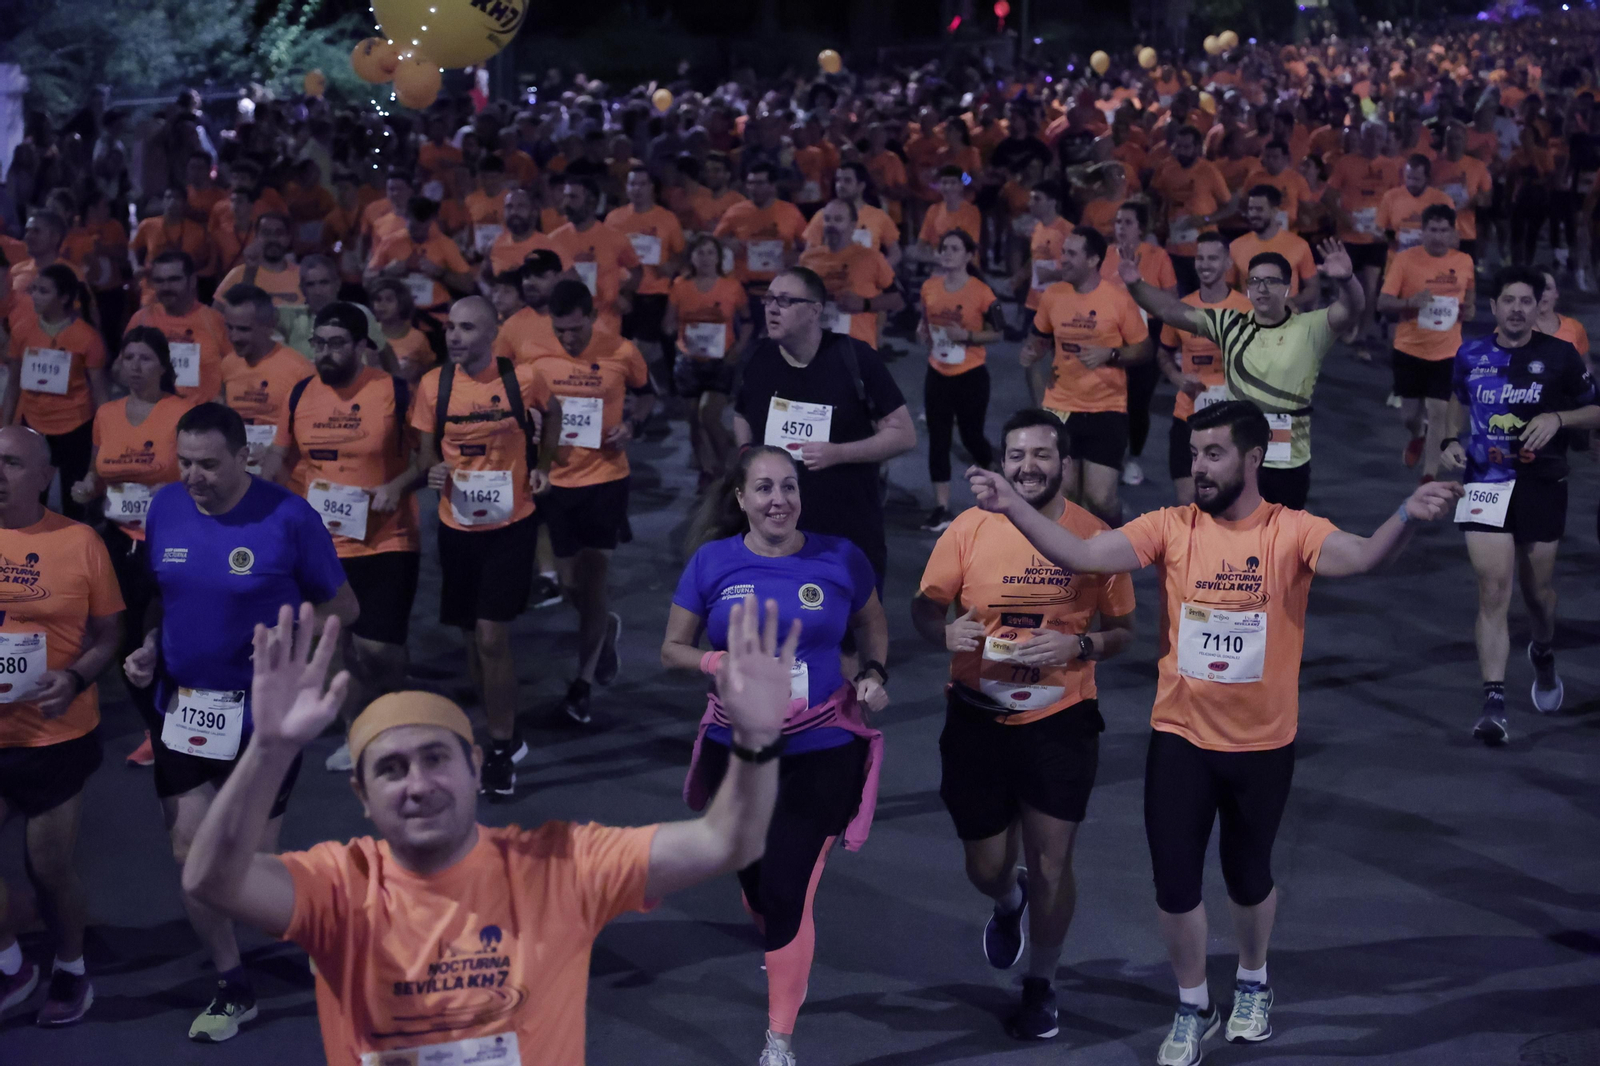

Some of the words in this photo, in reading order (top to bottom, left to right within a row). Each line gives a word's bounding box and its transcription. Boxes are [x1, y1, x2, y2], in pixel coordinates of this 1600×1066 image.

[562, 414, 591, 427] 5824
[781, 421, 813, 437] 4570
[462, 490, 500, 503] 11642
[1468, 490, 1500, 504] 15606
[121, 500, 148, 514] 8097
[323, 499, 352, 516] 9842
[1024, 567, 1073, 577] NOCTURNA
[1215, 573, 1263, 582] NOCTURNA
[1002, 575, 1046, 585] SEVILLA
[1195, 580, 1236, 591] SEVILLA
[1202, 632, 1243, 653] 7110
[1011, 665, 1040, 683] 778
[181, 706, 226, 730] 17390
[427, 955, 511, 976] NOCTURNA
[393, 975, 464, 996] SEVILLA
